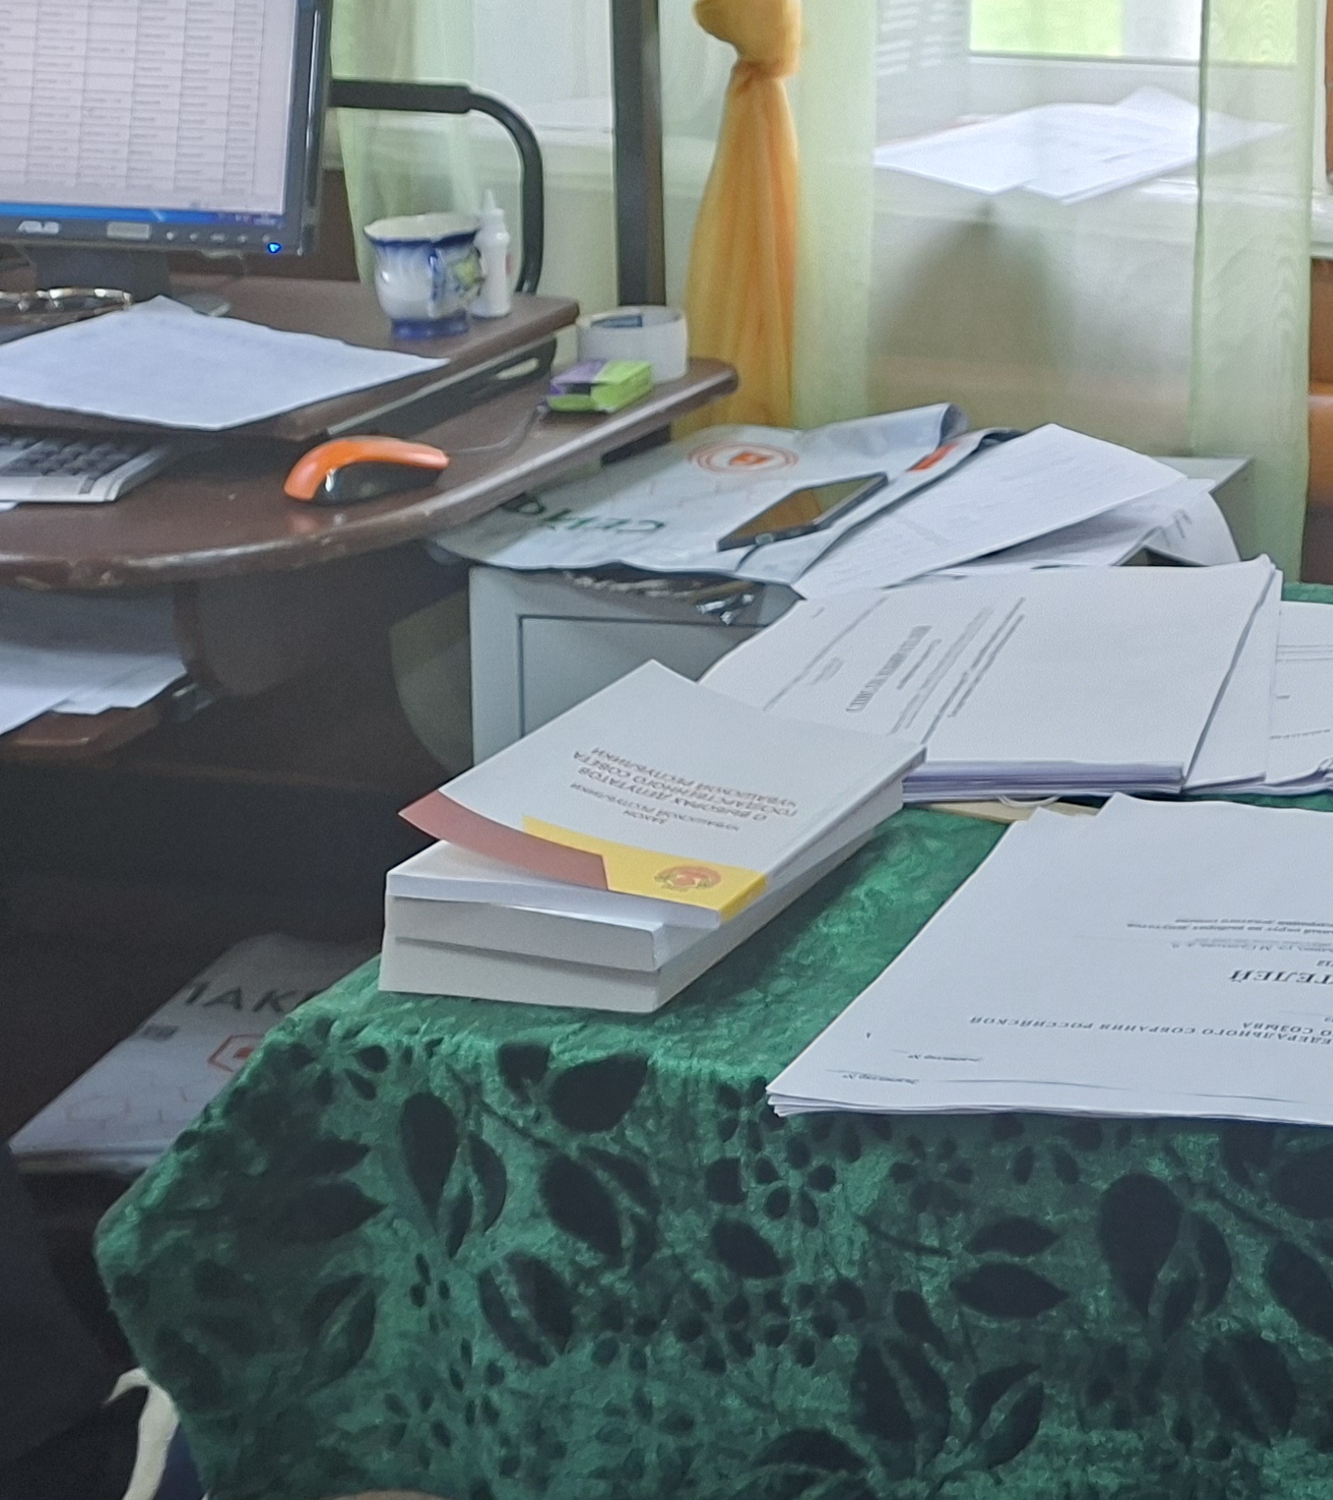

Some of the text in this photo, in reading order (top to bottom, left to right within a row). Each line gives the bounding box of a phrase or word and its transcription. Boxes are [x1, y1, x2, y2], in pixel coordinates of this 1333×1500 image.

[573, 751, 798, 817] ГОСУДАРСТВЕННОГО СОВЕТА
[578, 766, 672, 800] ДЕПУТАТОВ
[591, 747, 796, 808] ЧУВАШСКОЙ РЕСПУБЛИКИ
[674, 798, 751, 818] ВЫБОРАХ
[969, 1016, 1094, 1030] РОССИЙСКОЙ
[1098, 1023, 1196, 1034] СОБРАНИЯ
[1242, 1022, 1314, 1034] СОЗЫВА
